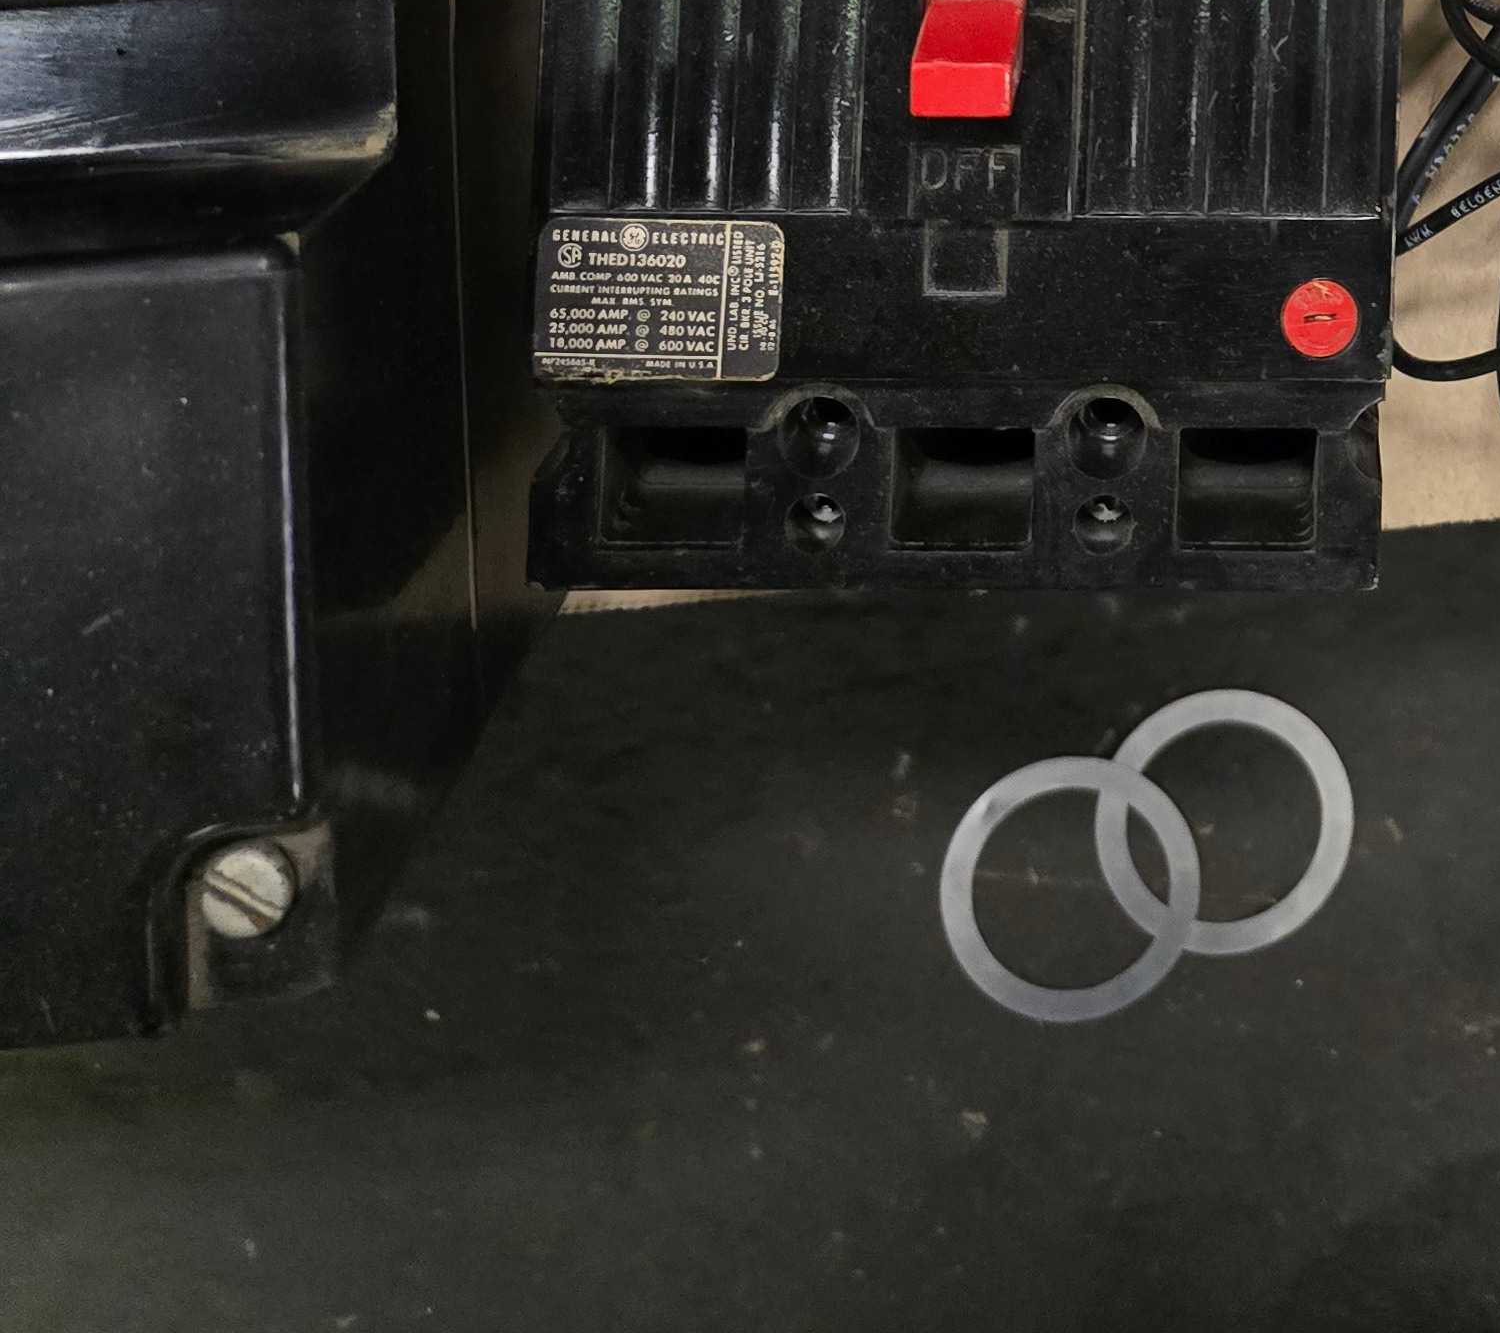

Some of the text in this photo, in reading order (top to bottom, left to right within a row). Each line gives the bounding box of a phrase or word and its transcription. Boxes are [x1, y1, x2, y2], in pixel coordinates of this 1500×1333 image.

[919, 147, 1010, 192] OFF
[552, 229, 725, 246] GENERAL ELECTRIC
[732, 231, 744, 265] LISTED
[588, 252, 687, 268] THED136020
[742, 240, 756, 294] POLE UNIT
[598, 285, 719, 297] INTERRUPTING RATINGS
[550, 308, 716, 323] 65,000 240 VAC
[549, 322, 716, 337] 25,000 480 VAC
[550, 337, 715, 353] 18,000 600 VAC
